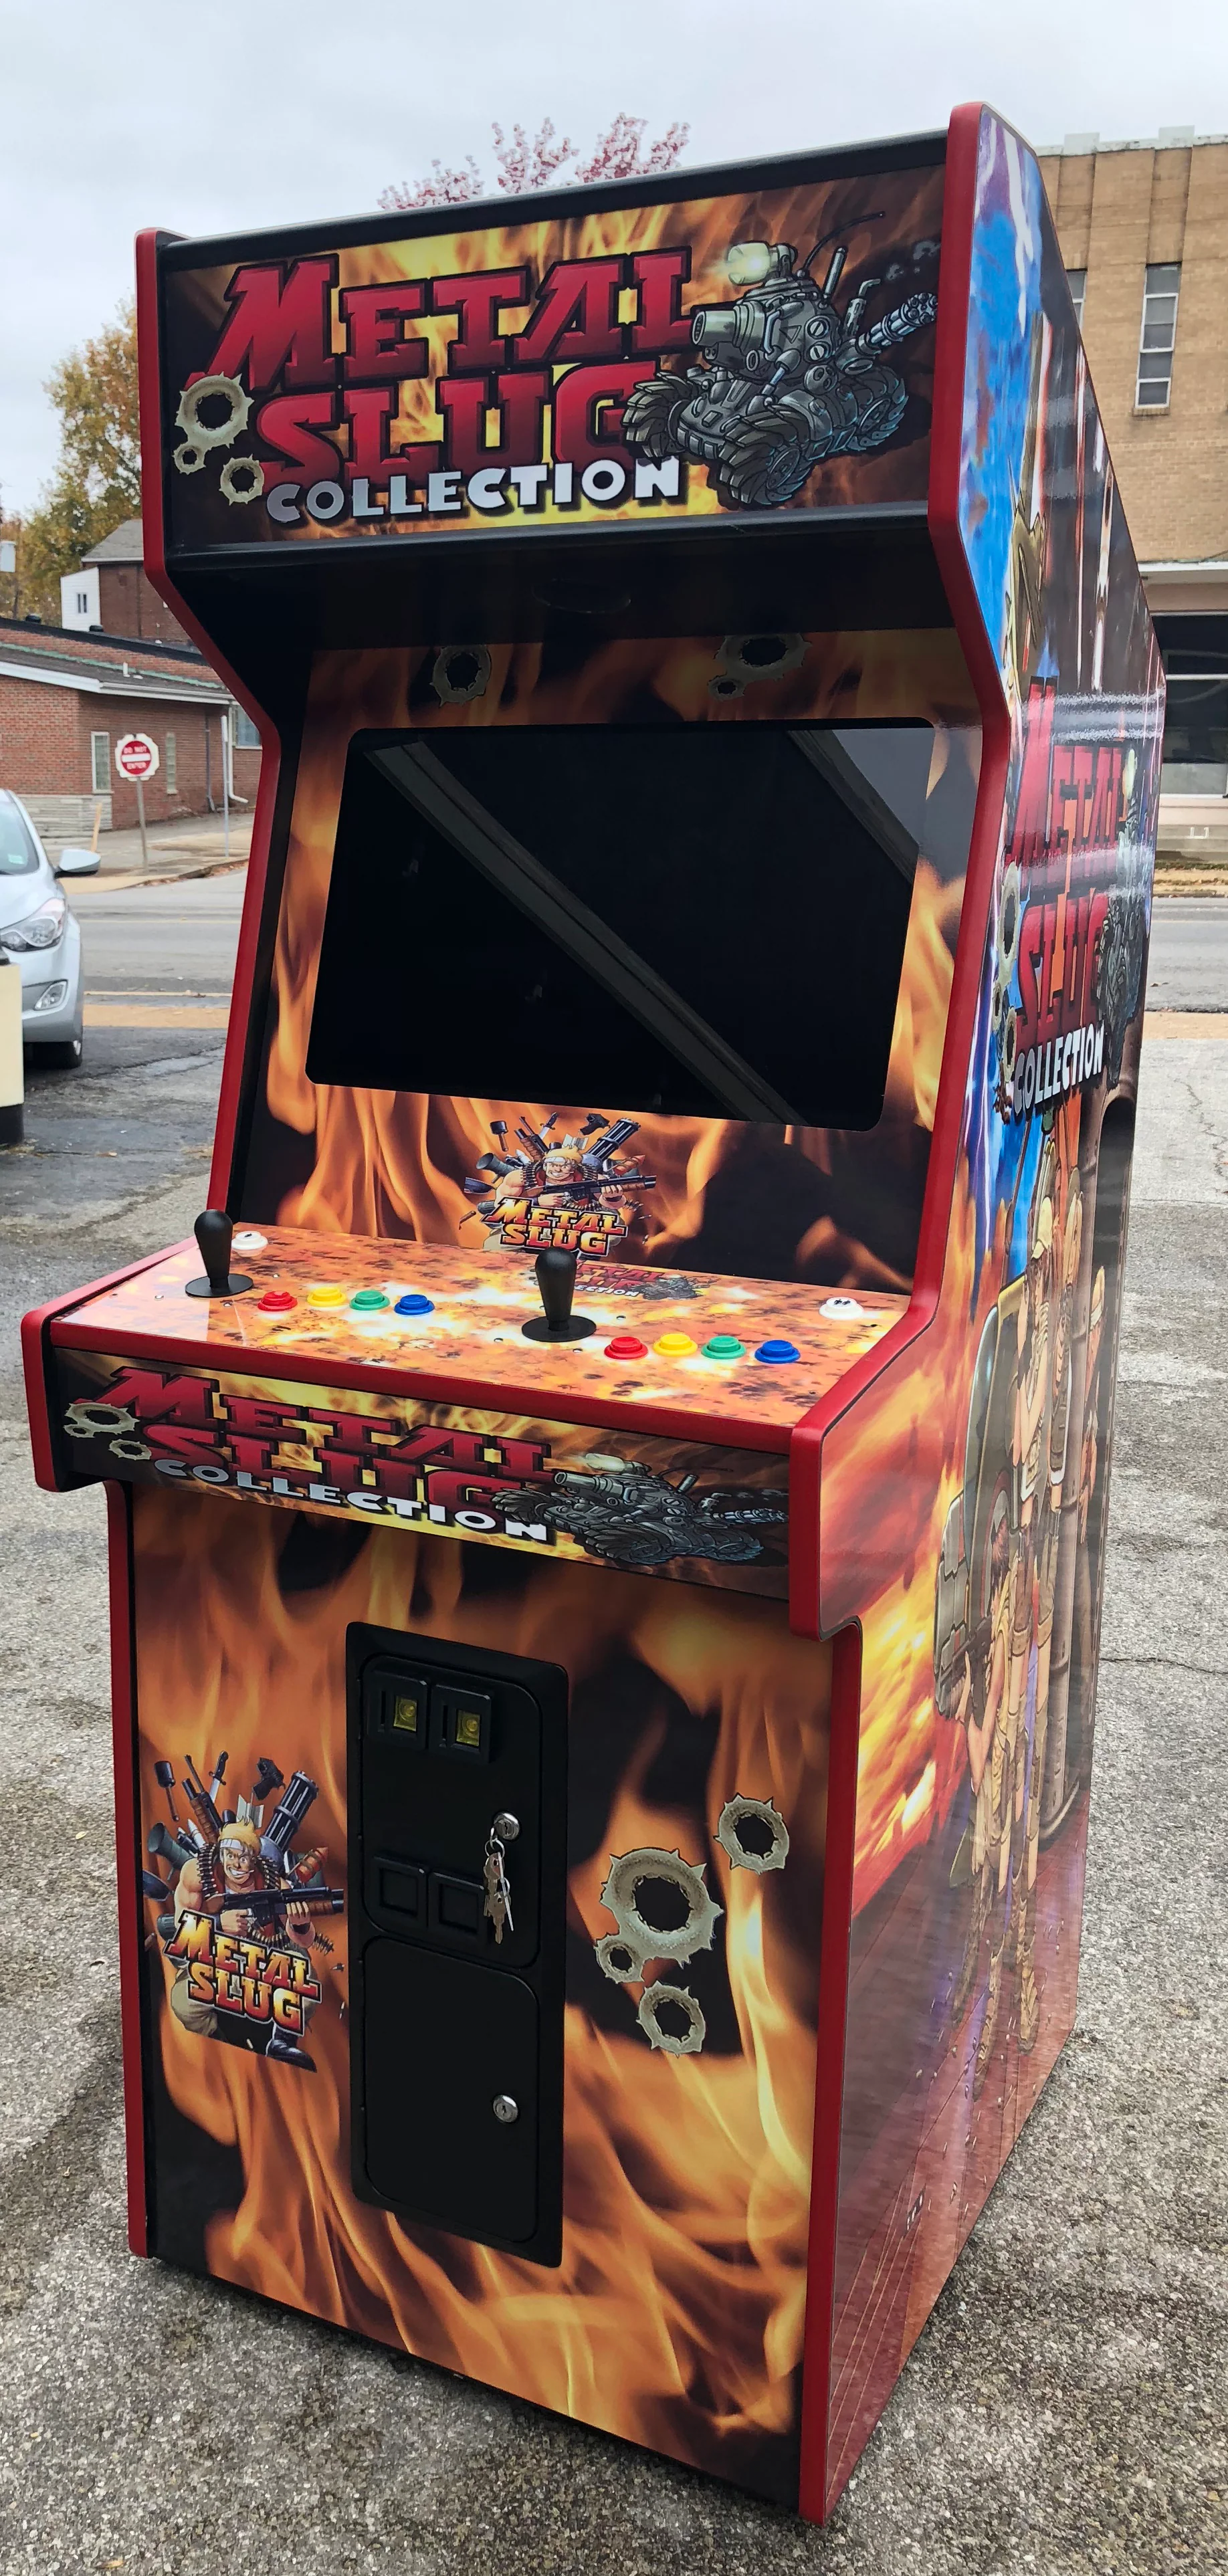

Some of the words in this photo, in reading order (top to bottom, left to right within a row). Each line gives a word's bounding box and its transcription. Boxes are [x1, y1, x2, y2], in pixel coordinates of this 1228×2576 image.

[187, 248, 692, 392] METAL
[254, 357, 659, 494] SLUG
[266, 457, 680, 521] COLLECTION
[1003, 675, 1124, 891] METAL
[1014, 892, 1109, 1062] SLUG
[1014, 1023, 1104, 1116] COLLECTION
[482, 1196, 628, 1237] METAL
[500, 1223, 610, 1256] SLUG
[575, 1284, 639, 1297] ECTION
[577, 1260, 666, 1283] ETAL
[87, 1366, 554, 1481] METAL
[139, 1420, 525, 1527] SLUG
[154, 1459, 547, 1541] COLLECTION
[163, 1911, 322, 2002] METAL
[188, 1962, 304, 2036] SLUG
